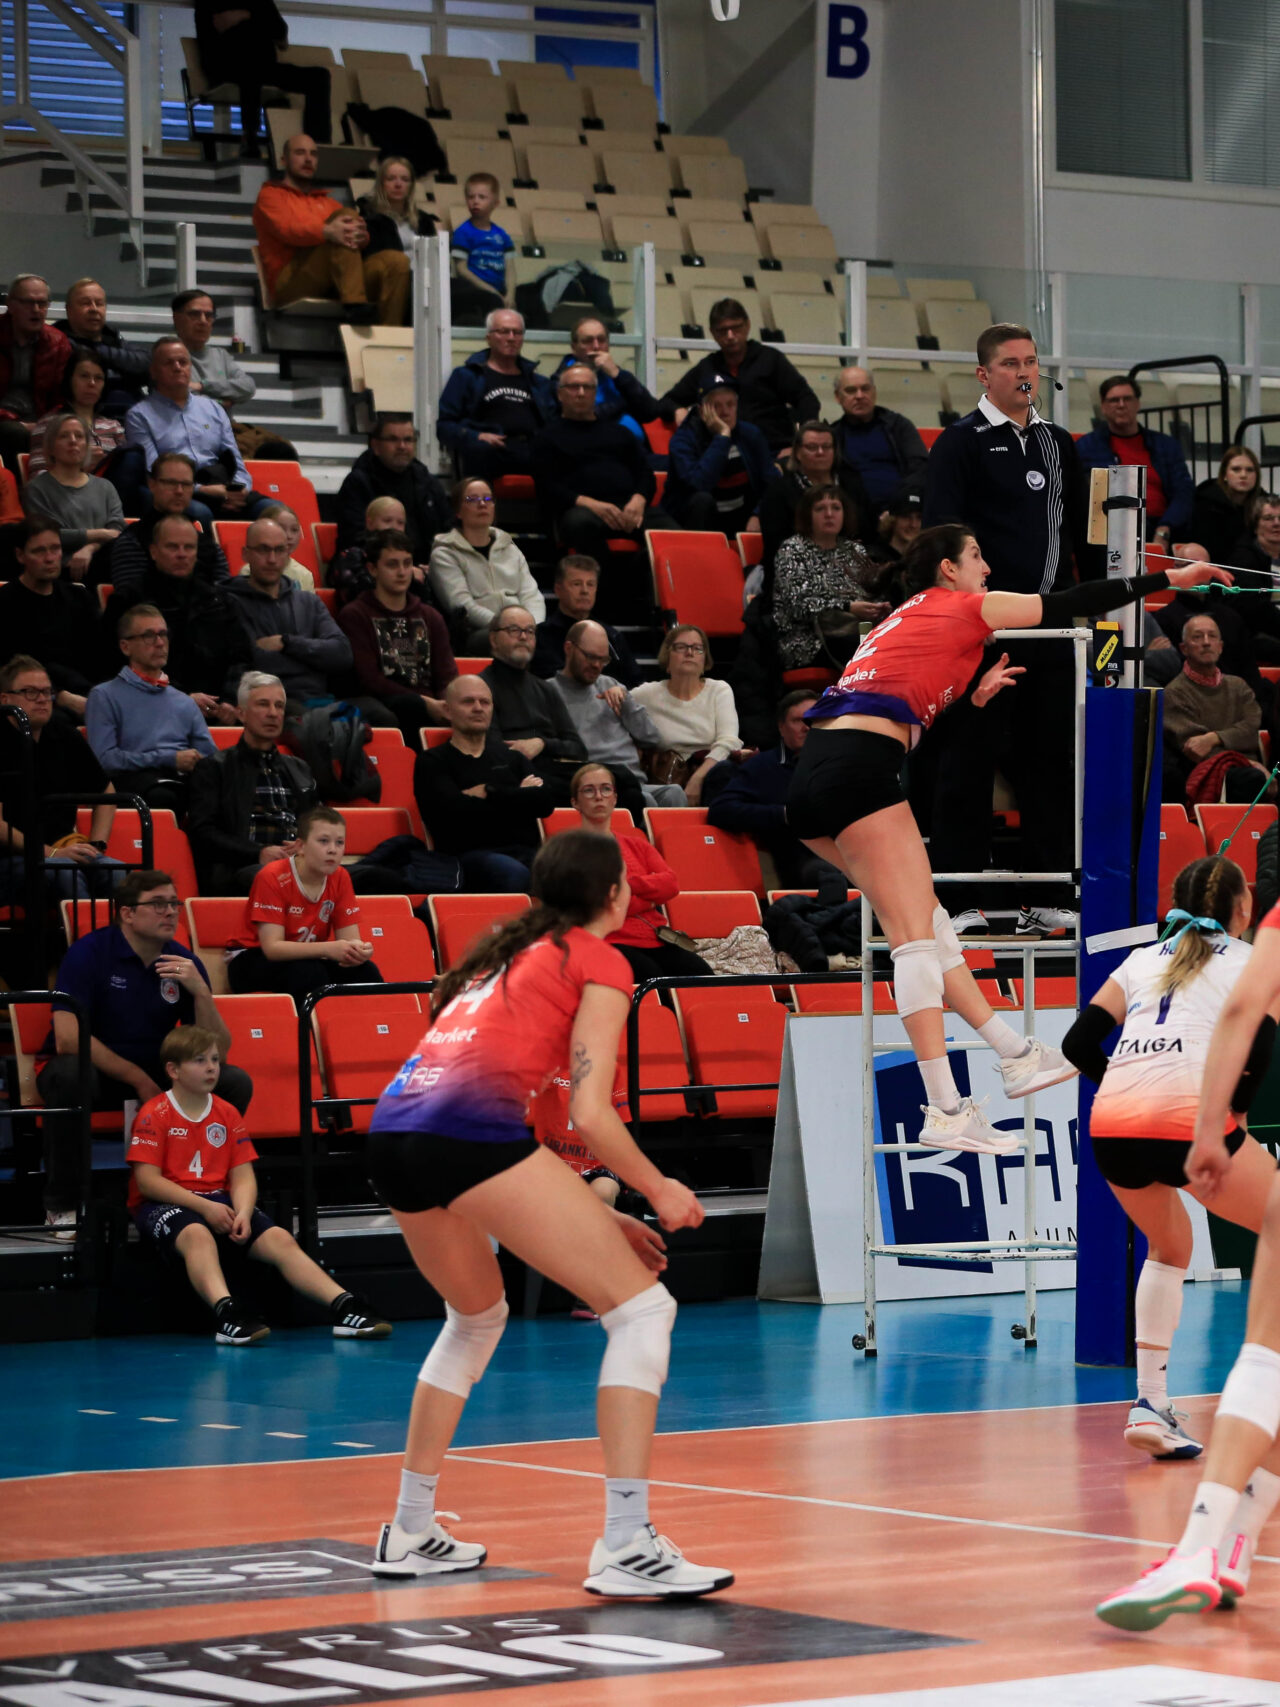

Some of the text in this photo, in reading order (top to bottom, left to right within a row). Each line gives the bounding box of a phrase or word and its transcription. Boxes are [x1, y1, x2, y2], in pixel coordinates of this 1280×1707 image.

[826, 3, 870, 79] B
[1100, 642, 1115, 664] MIKASA
[1118, 1037, 1183, 1055] TAIGA
[188, 1150, 204, 1179] 4
[896, 1117, 1078, 1210] KA
